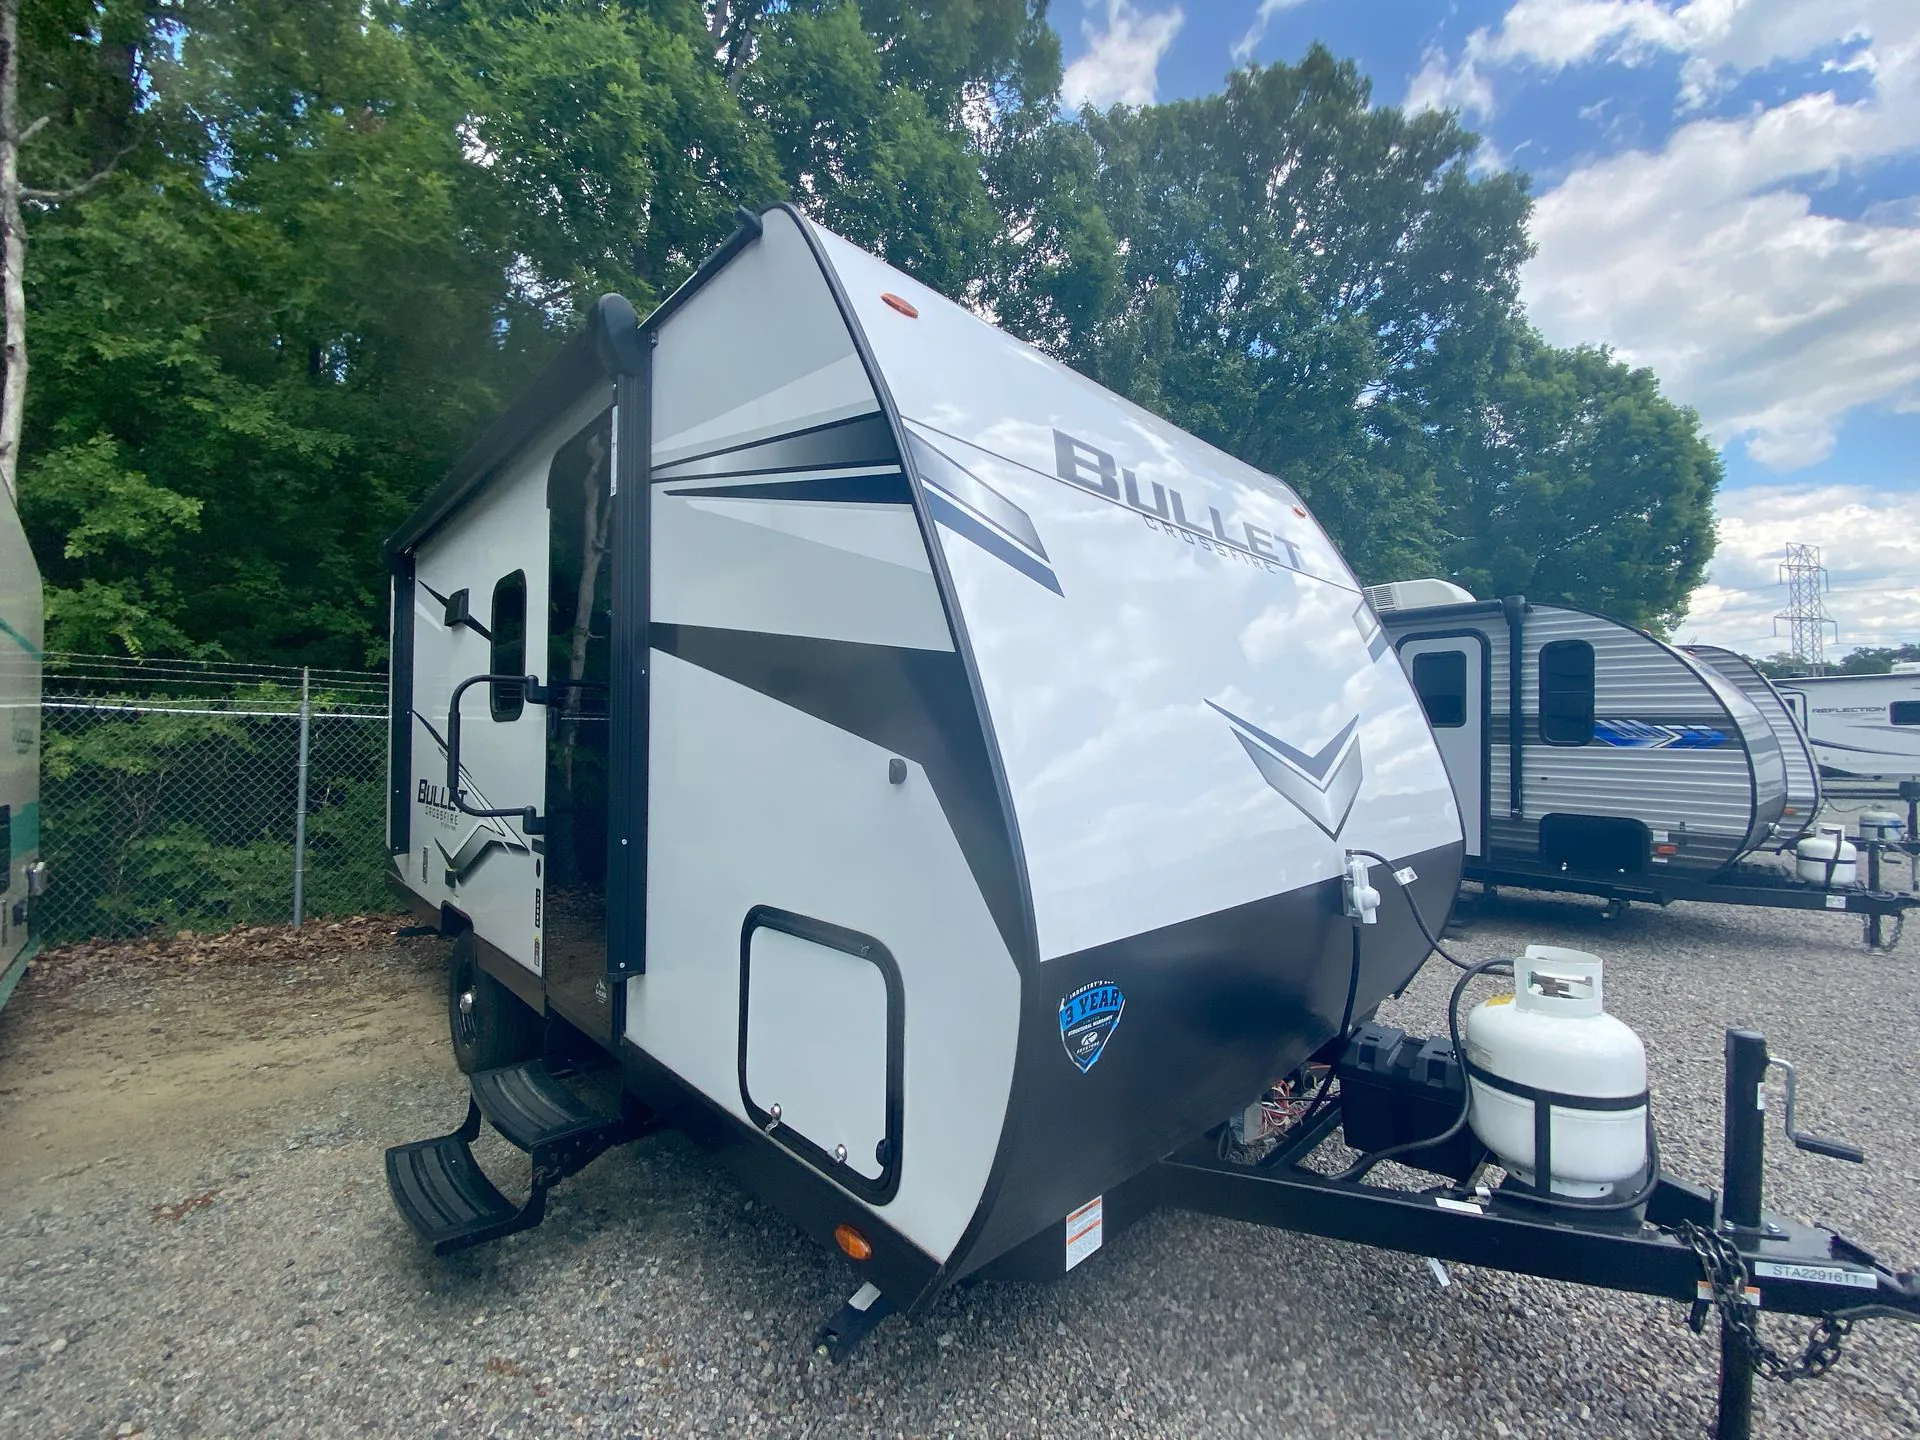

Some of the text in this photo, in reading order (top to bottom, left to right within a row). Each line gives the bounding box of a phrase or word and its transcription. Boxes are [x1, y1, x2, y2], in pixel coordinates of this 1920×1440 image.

[1053, 428, 1300, 569] BULLET
[1143, 514, 1277, 574] CROSSFIRE
[425, 806, 458, 825] CROSSFIRE
[1065, 988, 1119, 1025] 3 YEAR
[1773, 1265, 1859, 1284] STA2291611
